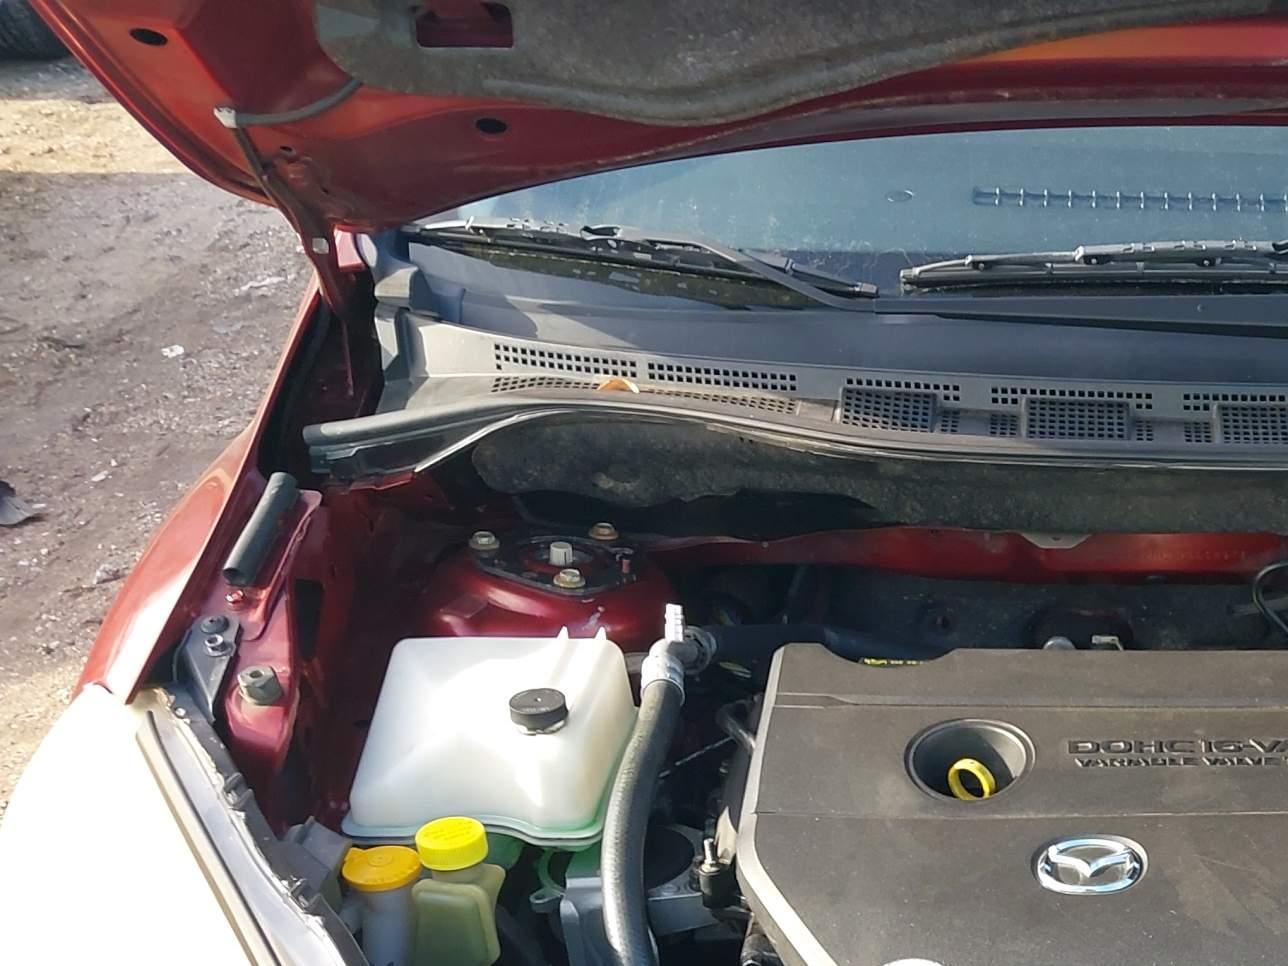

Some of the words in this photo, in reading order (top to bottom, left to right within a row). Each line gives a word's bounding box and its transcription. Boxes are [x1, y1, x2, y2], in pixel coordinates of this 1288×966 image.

[1068, 740, 1196, 754] DOHC
[1074, 757, 1199, 768] VARIABLE
[1201, 756, 1281, 767] VALVE
